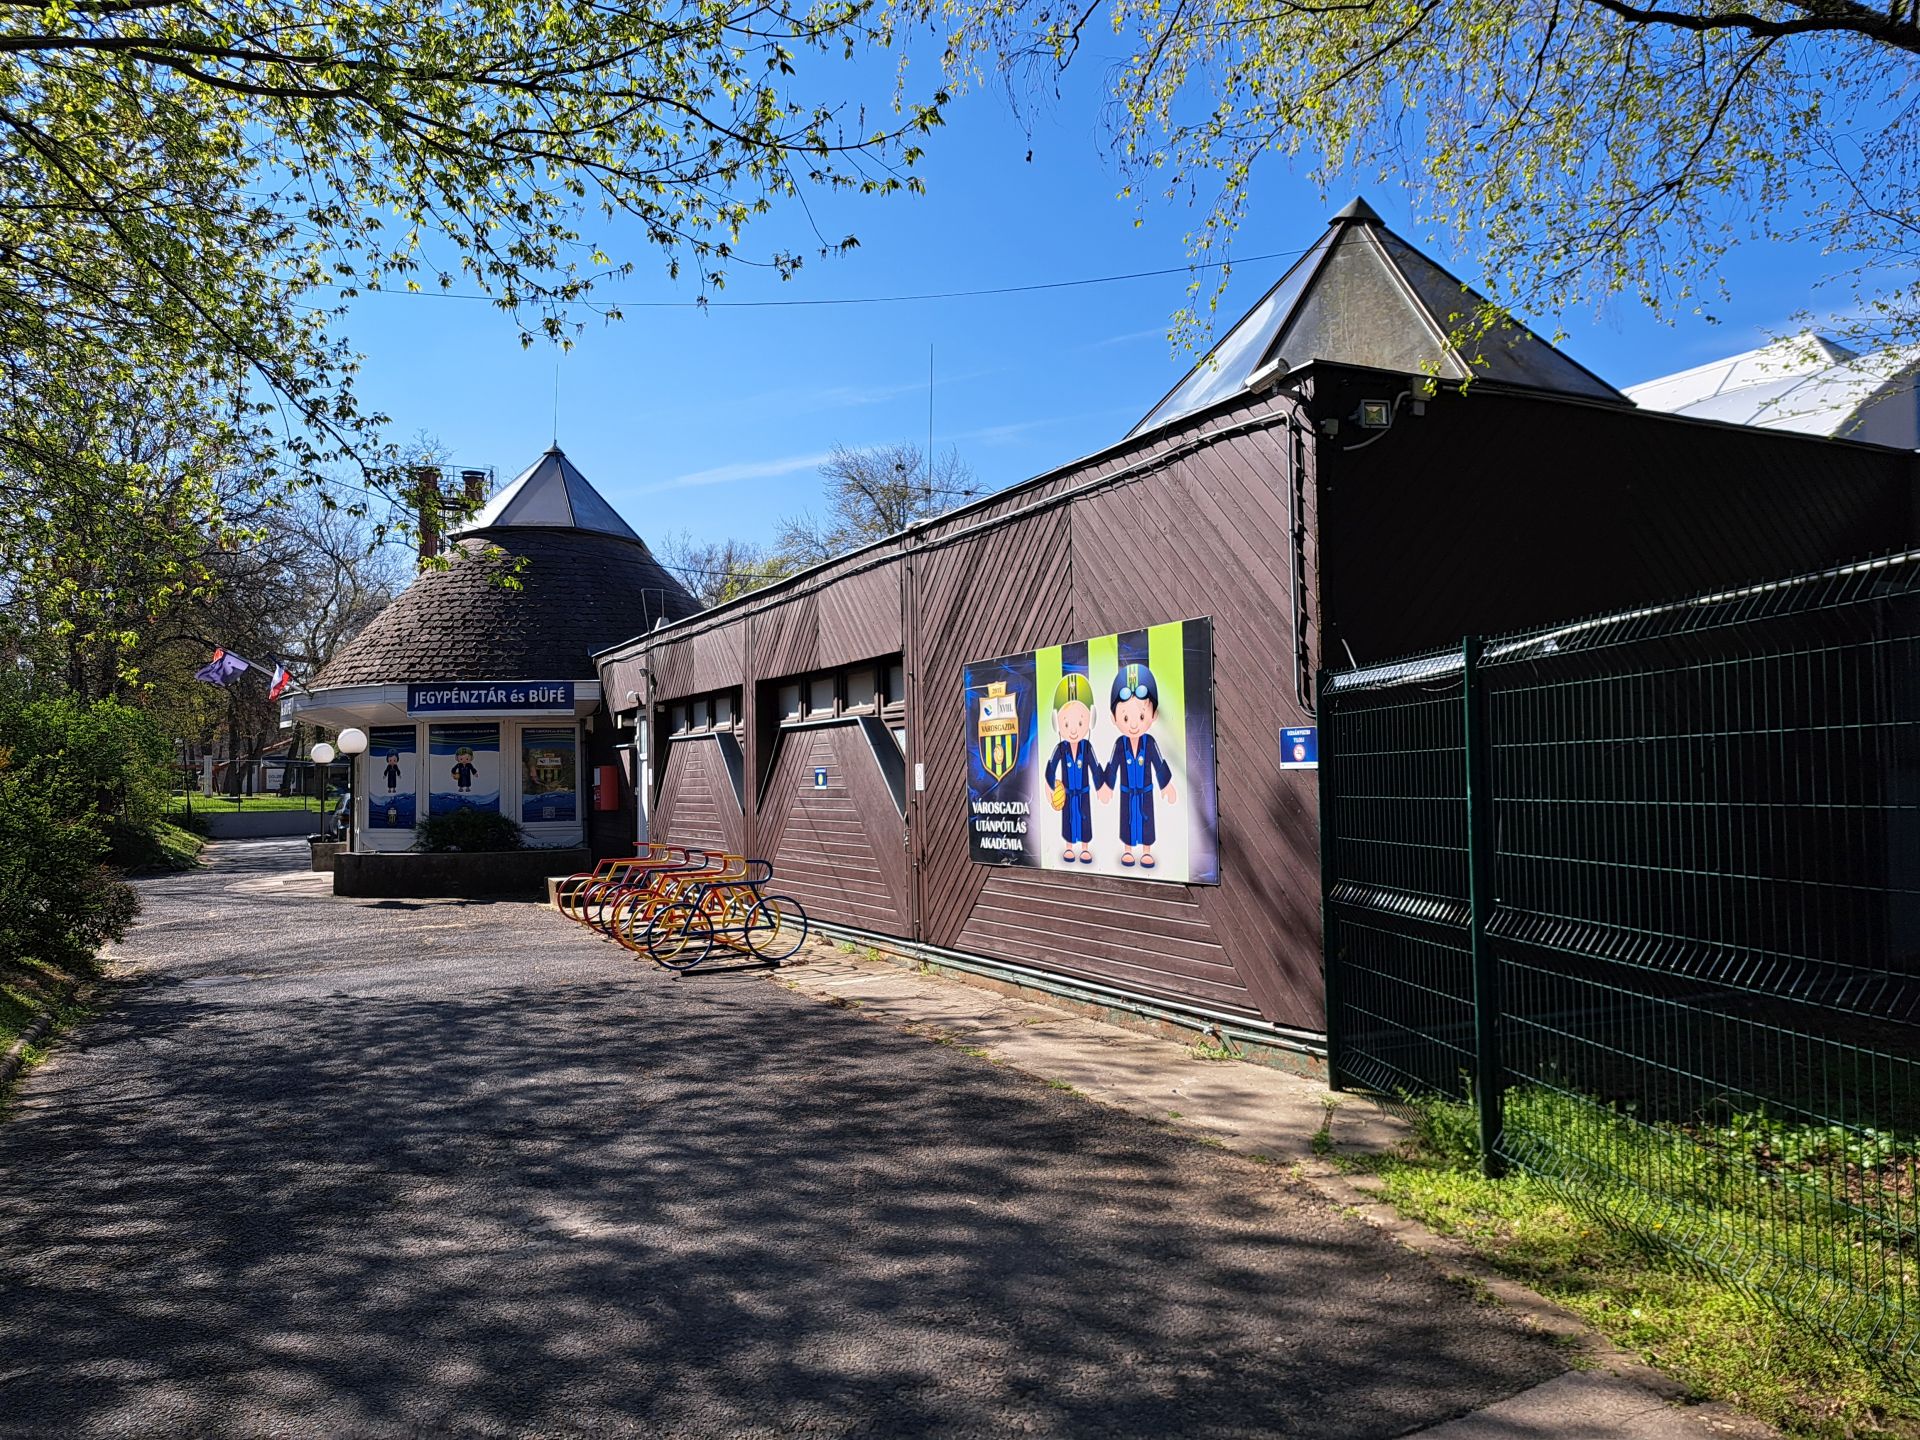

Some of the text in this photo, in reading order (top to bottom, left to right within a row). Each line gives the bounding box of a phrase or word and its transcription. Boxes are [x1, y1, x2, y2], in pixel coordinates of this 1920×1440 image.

[414, 686, 566, 708] JEGYPÉNZTÁR és BÜFÉ
[981, 722, 1016, 733] VÁROSGAZDA
[972, 798, 1030, 814] VÁROSGAZDA
[976, 816, 1026, 834] UTÁNPÓTLÁS
[980, 834, 1022, 850] AKADÉMIA
